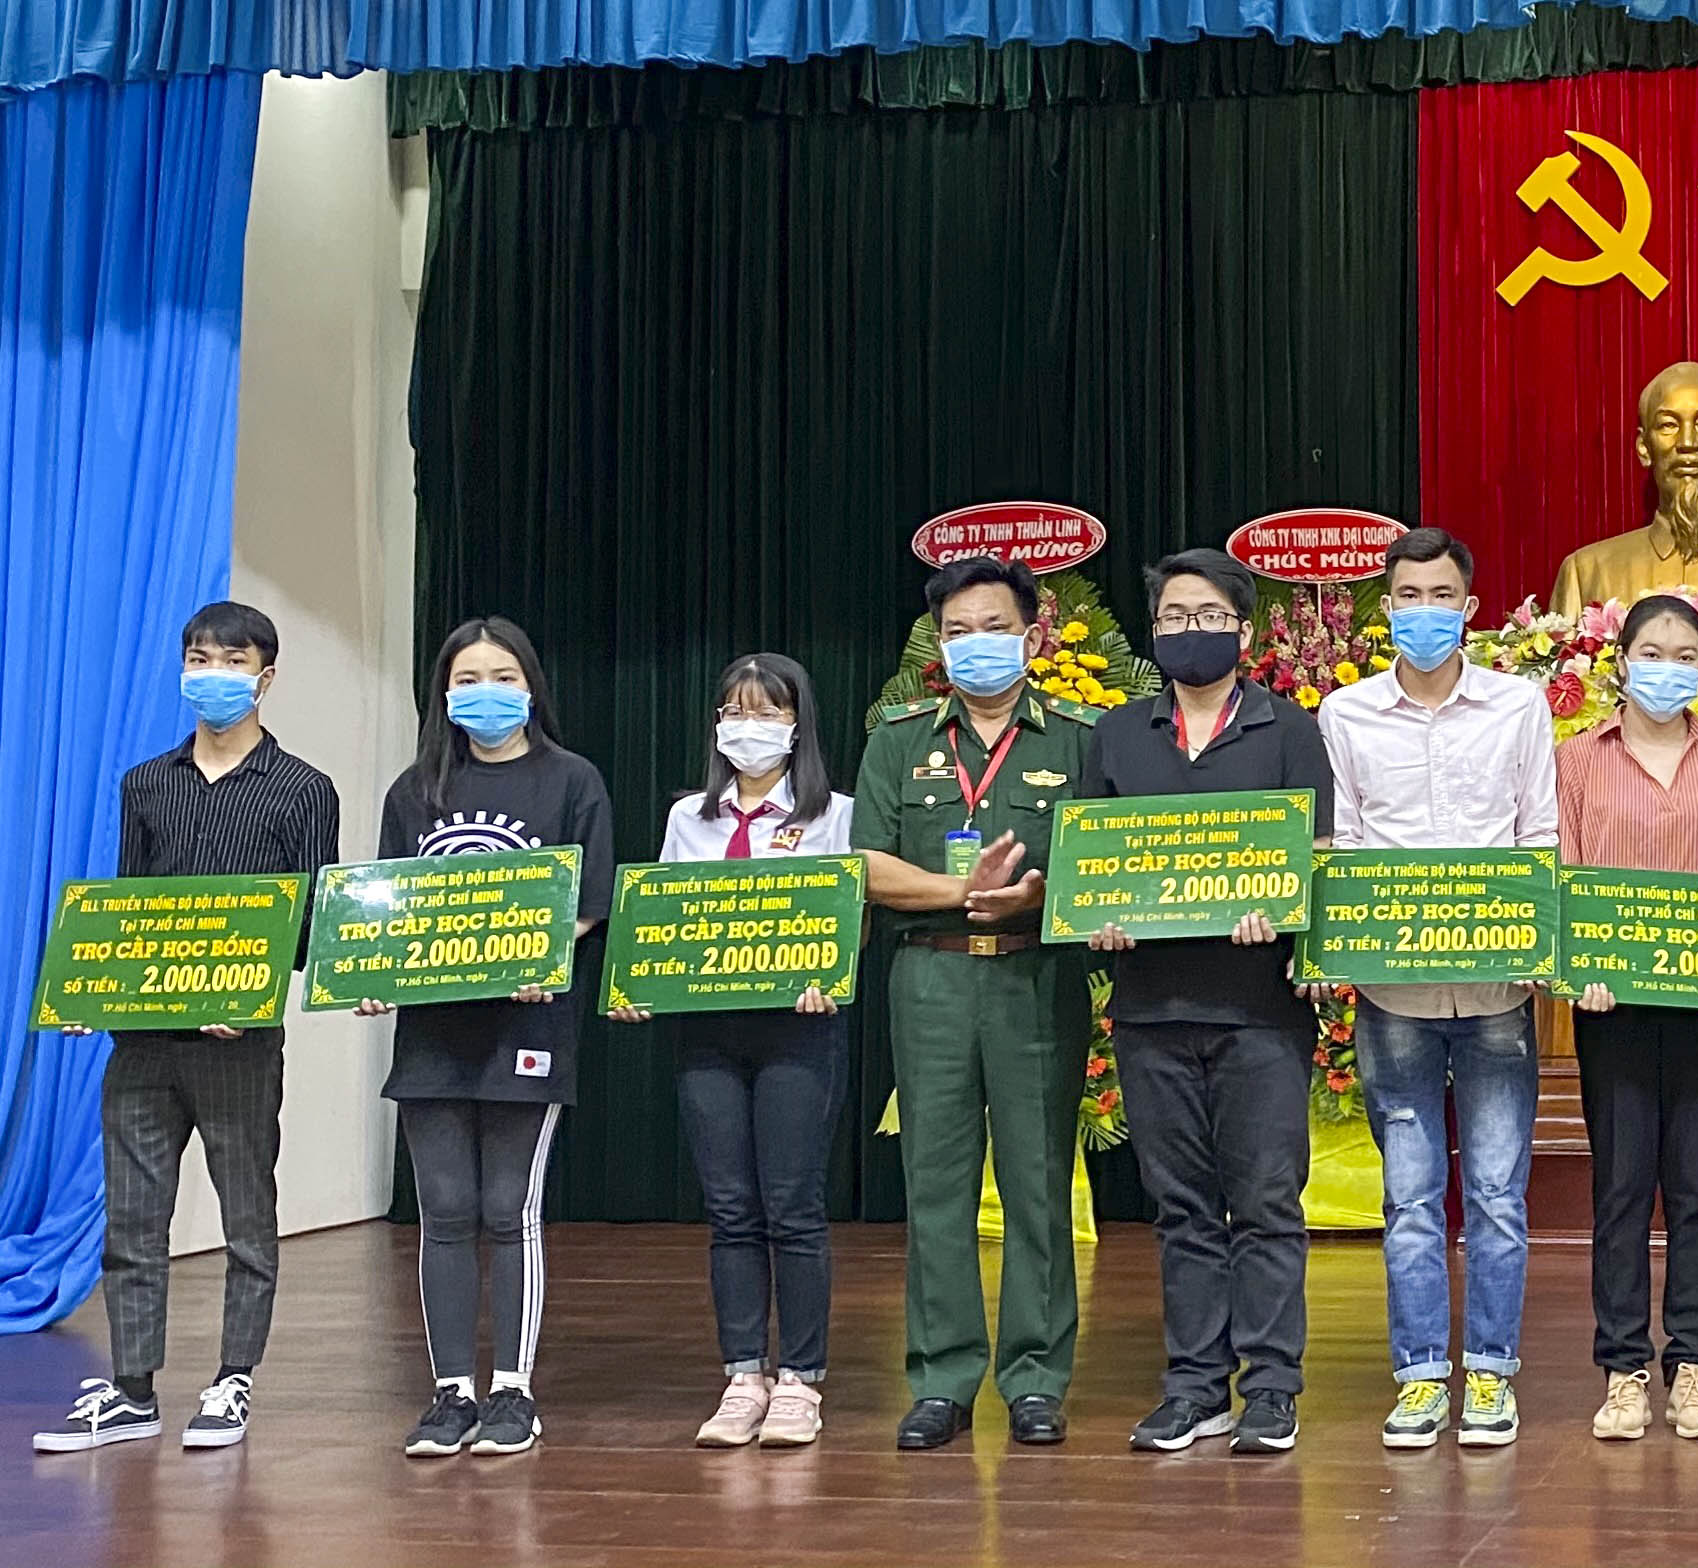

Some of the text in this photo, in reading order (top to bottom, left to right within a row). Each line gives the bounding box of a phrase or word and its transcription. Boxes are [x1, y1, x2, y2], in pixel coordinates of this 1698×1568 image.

[934, 523, 964, 544] CÔNG
[968, 525, 981, 542] TY
[983, 523, 1013, 541] TNHH
[1055, 519, 1081, 537] LINH
[1249, 526, 1397, 549] CÔNG TY TNHH XNK ĐẠI QUANG
[1009, 542, 1084, 560] MỪNG
[1249, 547, 1386, 570] CHÚC MỪNG
[1159, 871, 1300, 904] 2.000.000Đ
[682, 901, 700, 915] Tại
[762, 897, 792, 909] MINH
[1326, 904, 1369, 924] TRỢ
[1422, 903, 1470, 922] HỌC
[1475, 896, 1535, 919] BỔNG
[635, 925, 676, 946] TRỢ
[727, 920, 774, 942] HỌC
[777, 910, 837, 937] BỔNG
[1395, 924, 1537, 952] 2.000.000Đ
[1571, 922, 1613, 942] TRỢ
[72, 942, 111, 963] TRỢ
[161, 941, 207, 961] HỌC
[210, 930, 268, 957] BỔNG
[404, 931, 550, 969] 2.000.000Đ
[700, 941, 838, 975] 2.000.000Đ
[140, 963, 270, 993] 2.000.000Đ
